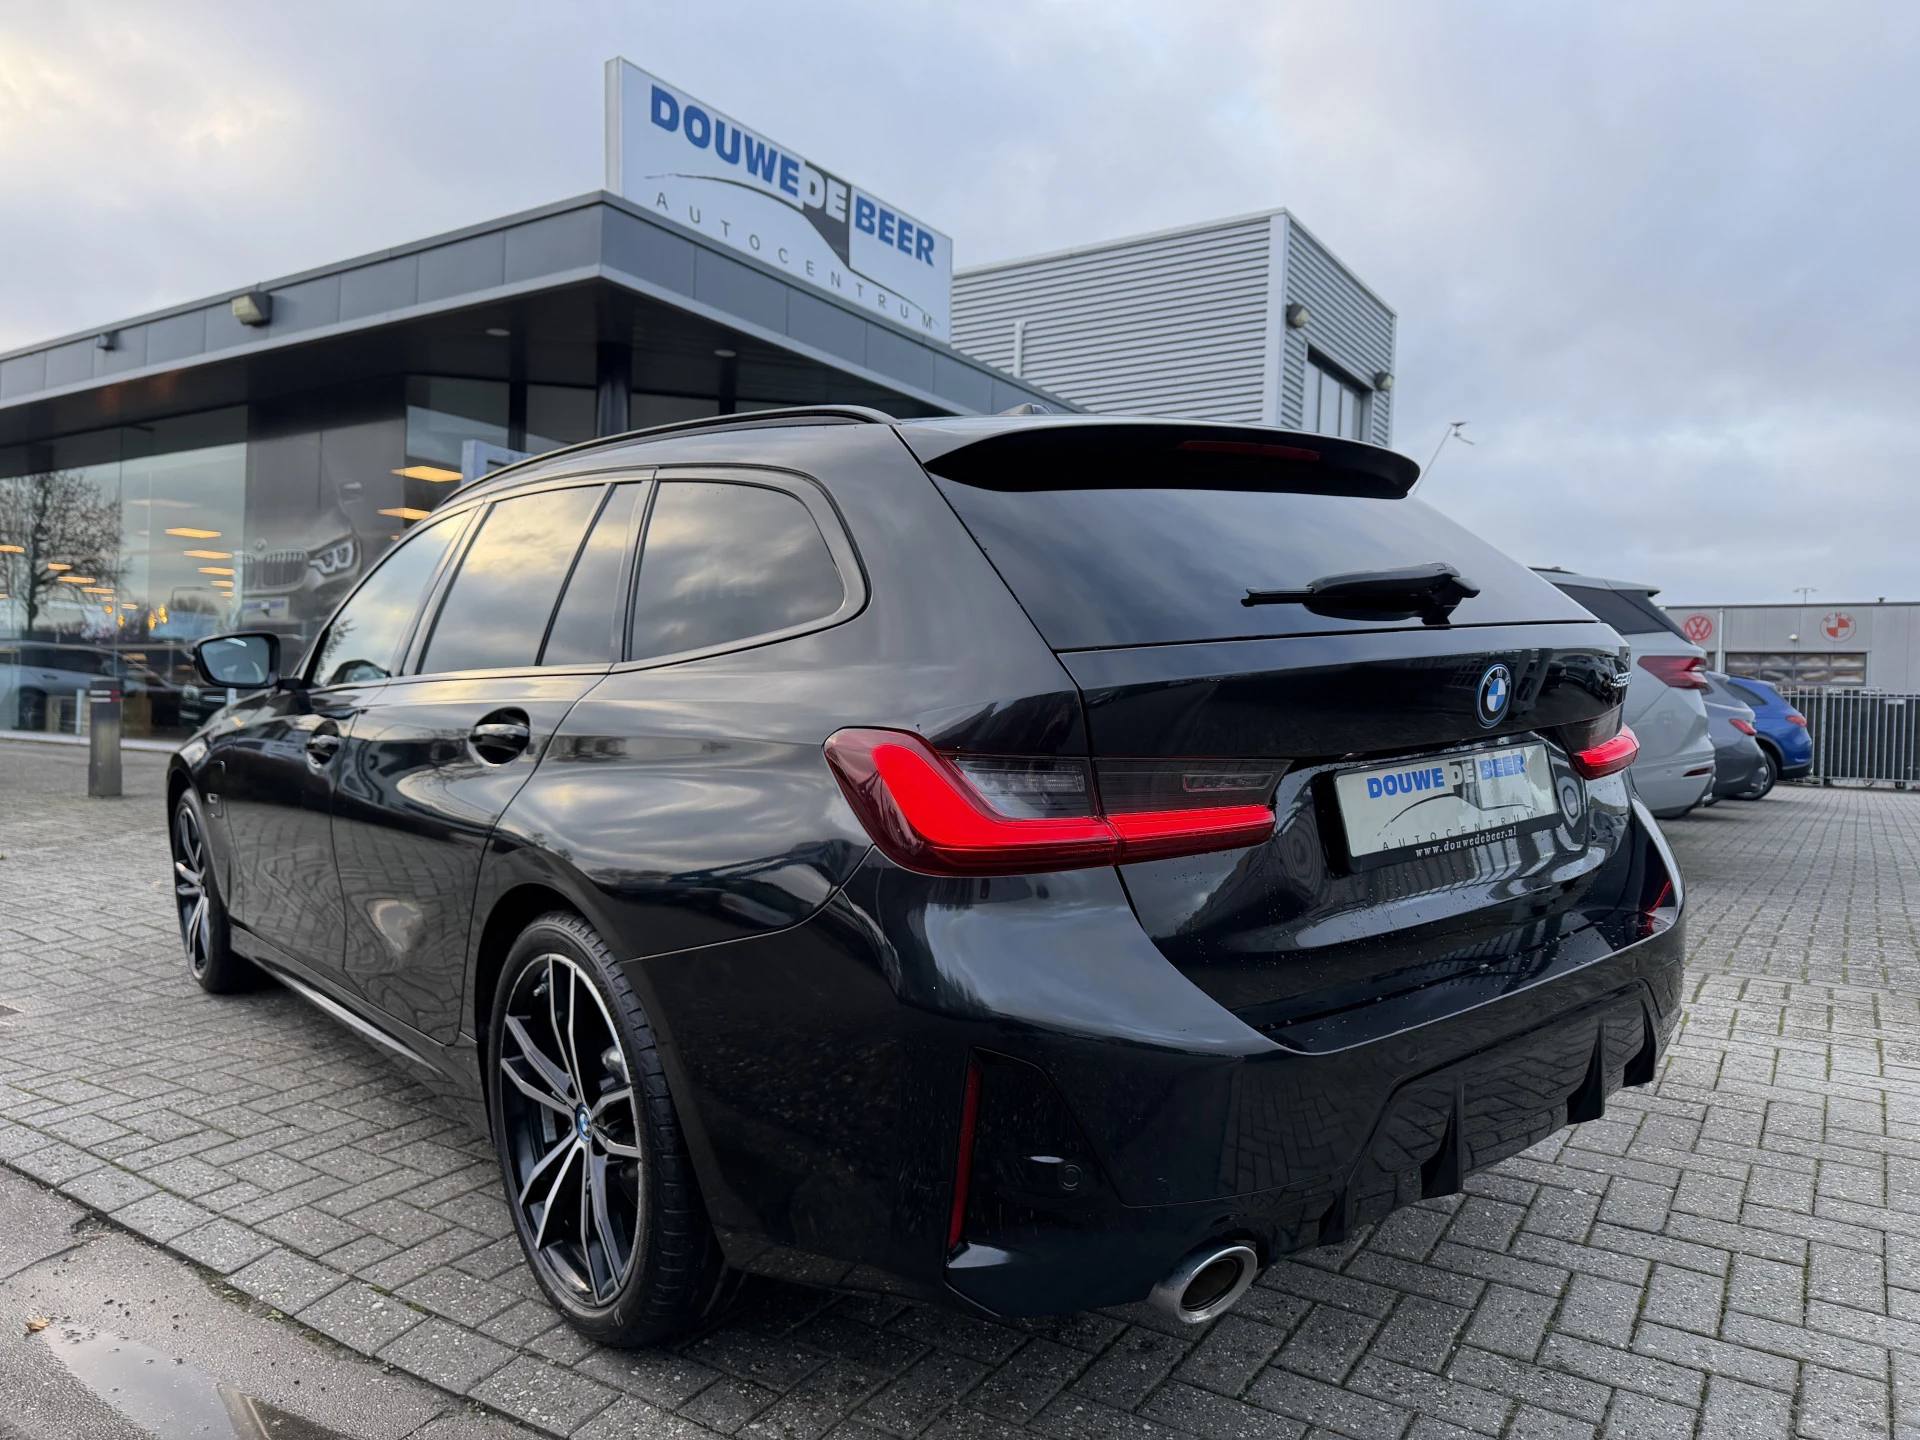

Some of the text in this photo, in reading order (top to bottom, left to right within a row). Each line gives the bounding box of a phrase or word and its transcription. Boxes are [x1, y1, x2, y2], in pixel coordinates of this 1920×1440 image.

[651, 84, 934, 267] DOUWE DE BEER
[656, 192, 933, 328] AUTOCENTRUM
[1367, 755, 1526, 798] DOUWE DE BEER
[1382, 811, 1535, 850] AUTOCENTRUM
[1414, 825, 1517, 858] www.douwedebeer.nl
